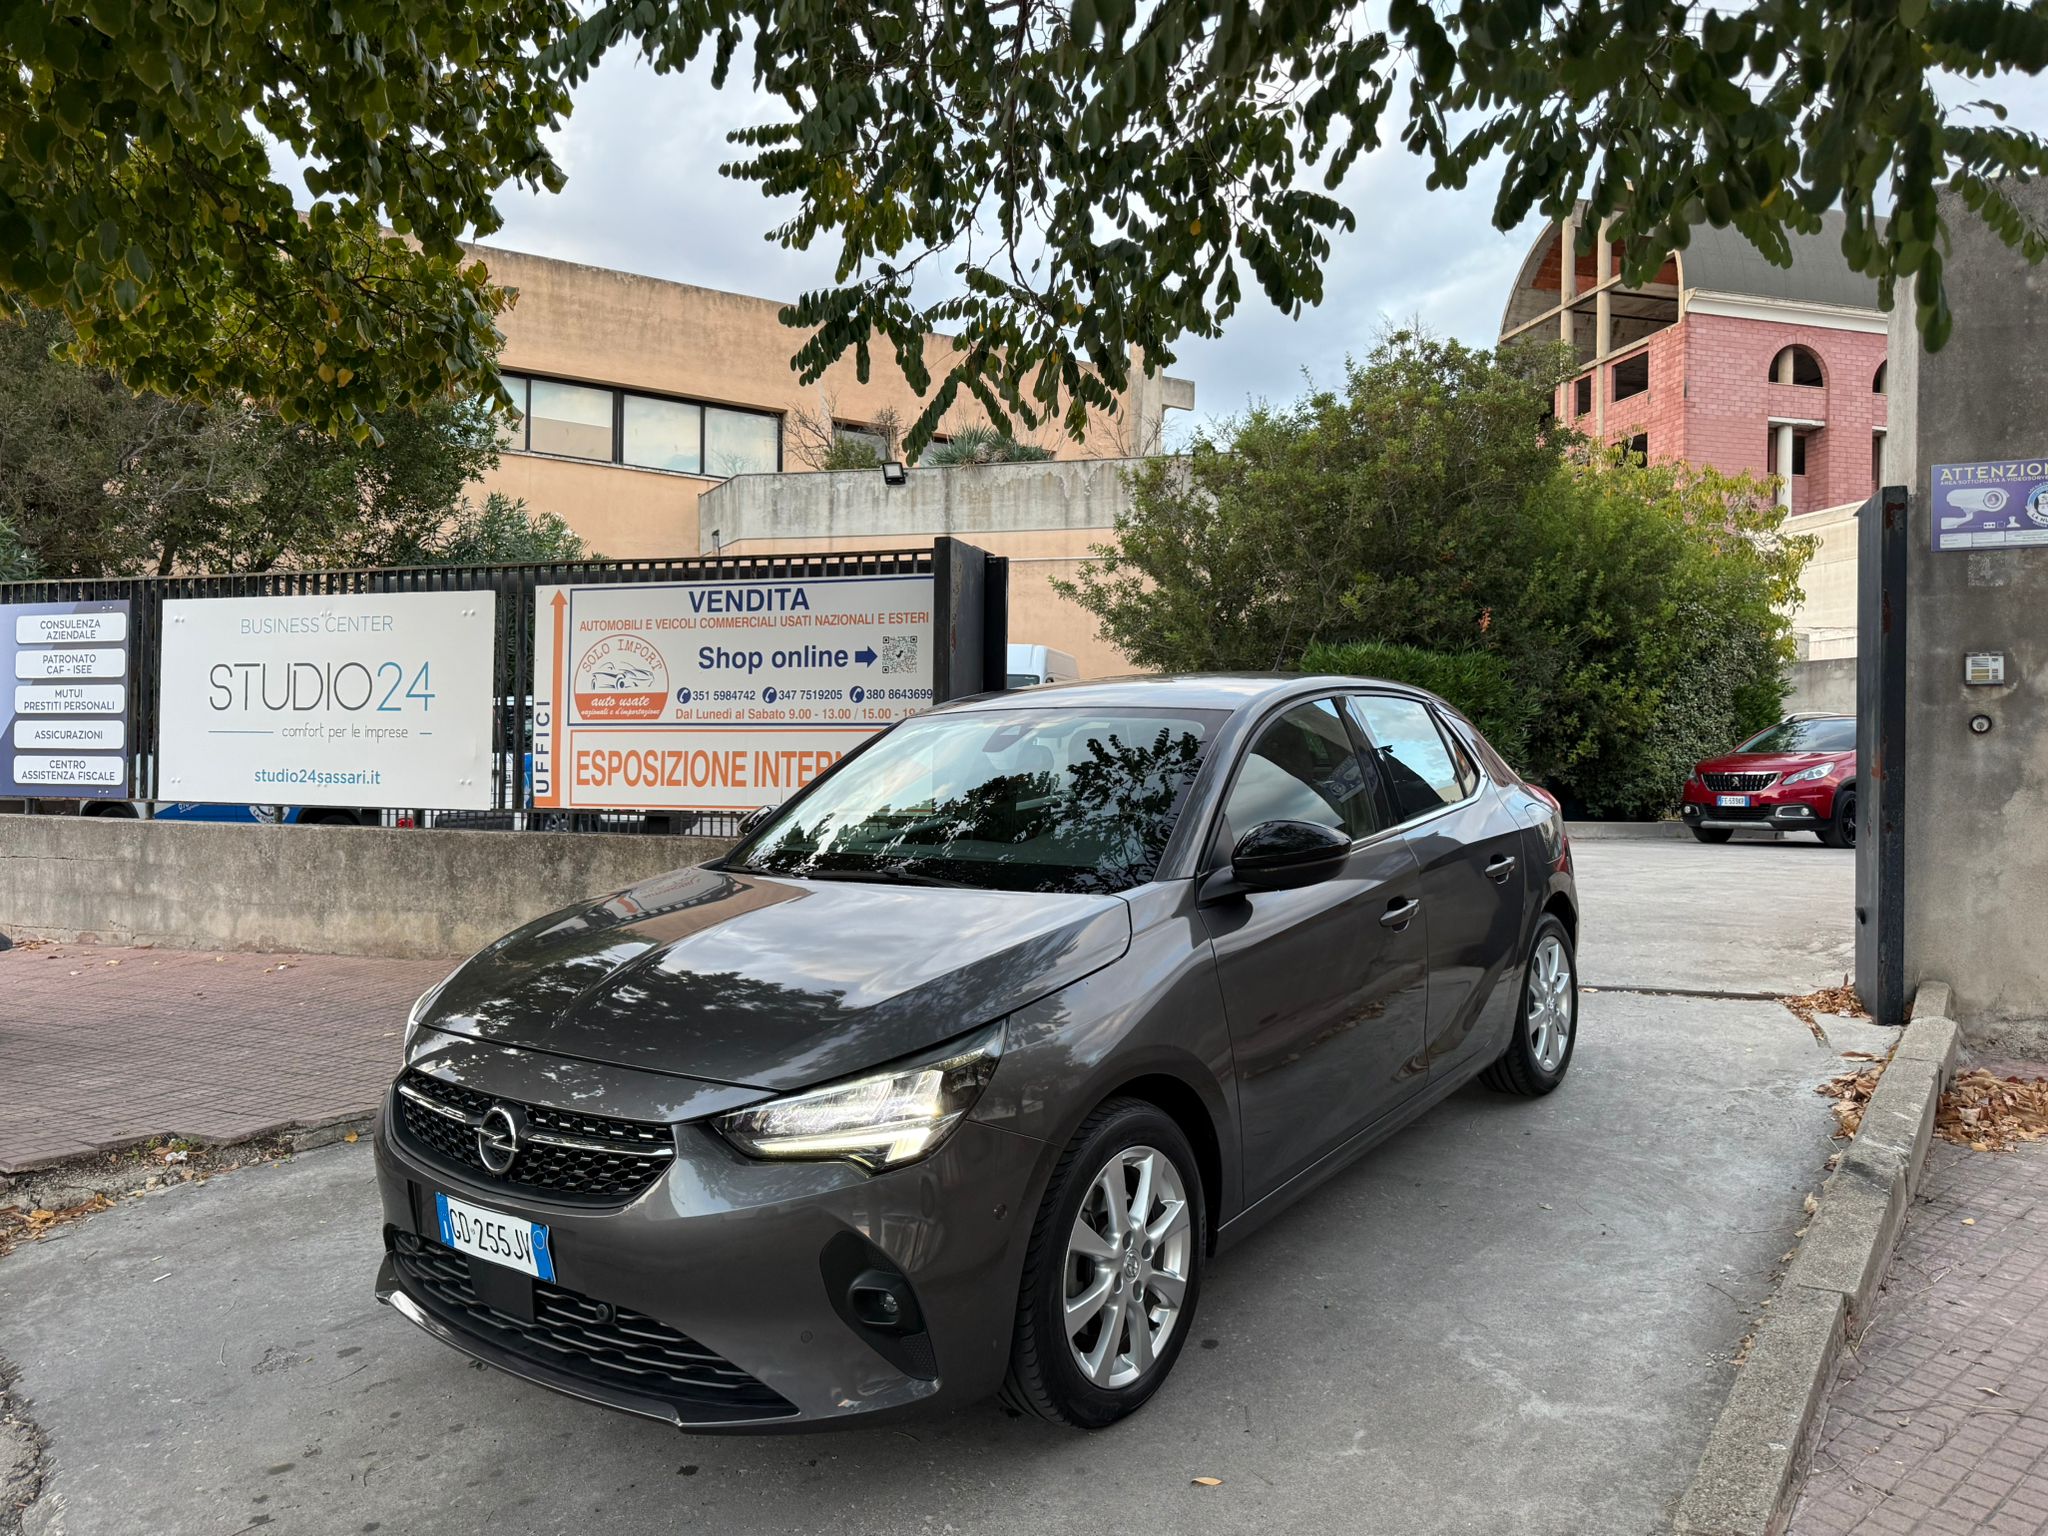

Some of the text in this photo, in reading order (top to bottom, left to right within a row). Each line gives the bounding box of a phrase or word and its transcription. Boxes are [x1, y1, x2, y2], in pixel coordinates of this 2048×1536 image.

[689, 587, 810, 613] VENDITA
[40, 619, 101, 630] CONSULENZA
[241, 615, 393, 635] BUSINESS CENTER
[580, 611, 929, 632] AUTOMOBILI E VEICOLI COMMERCIALI USATI NAZIONALI E ESTERI
[46, 630, 96, 640] AZIENDALE
[42, 653, 97, 664] PATRONATO
[582, 638, 663, 673] SOLO IMPORT
[698, 644, 849, 675] Shop online
[46, 665, 64, 675] CAF
[73, 665, 92, 674] ISEE
[209, 661, 435, 712] STUDIO24
[55, 688, 83, 698] MUTUI
[692, 690, 756, 701] 351 5984742
[778, 689, 843, 700] 347 7519205
[866, 688, 933, 700] 380 8643699
[24, 701, 115, 711] PRESTITI PERSONALI
[591, 695, 650, 707] auto usate
[675, 708, 693, 720] Dal
[735, 708, 745, 719] al
[748, 708, 786, 720] Sabato
[789, 708, 812, 719] 9.00
[823, 708, 852, 720] 13.00
[862, 708, 891, 719] 15.00
[34, 730, 103, 740] ASSICURAZIONI
[282, 722, 408, 743] comfort per le imprese
[535, 701, 550, 794] UFFICI
[49, 760, 86, 770] CENTRO
[576, 749, 844, 787] ESPOSIZIONE INTER
[21, 770, 115, 781] ASSISTENZA FISCALE
[254, 768, 381, 785] studio24sassari.it
